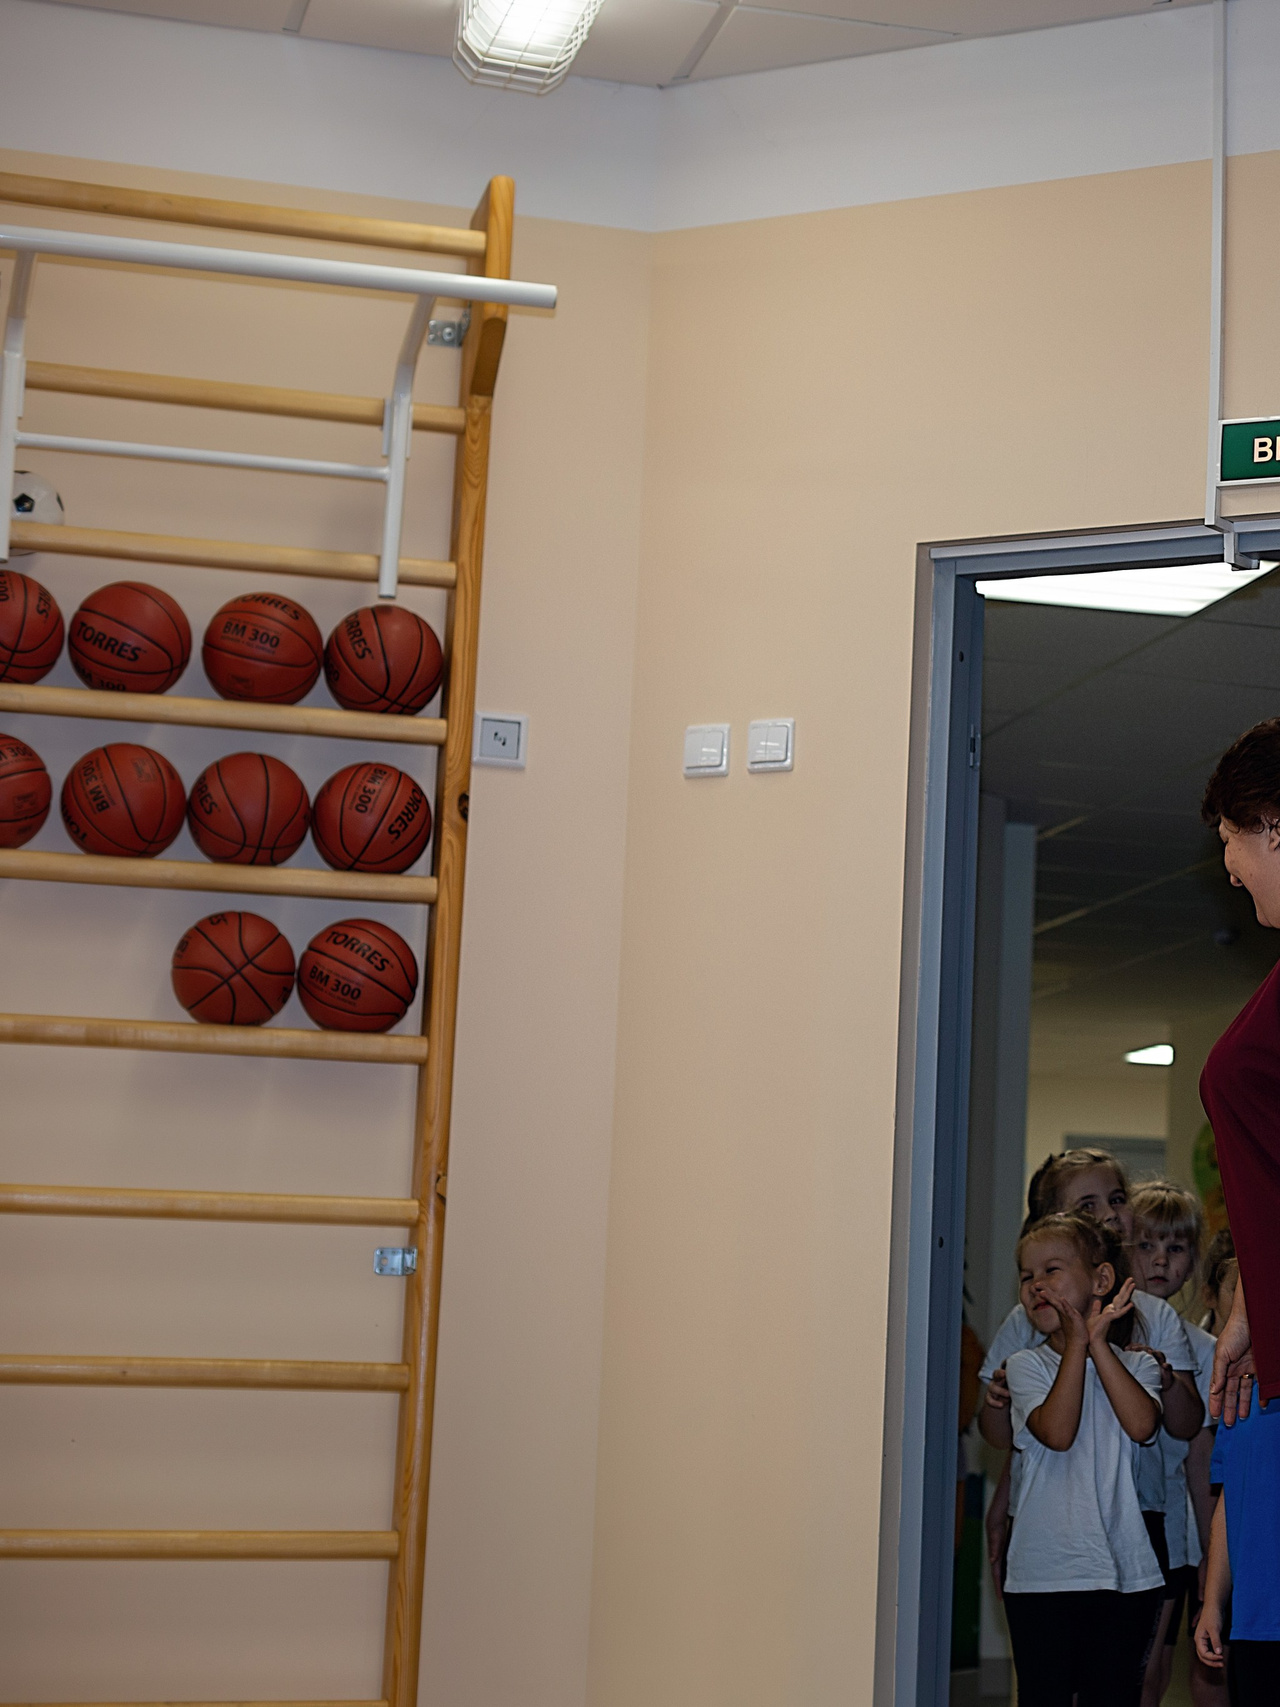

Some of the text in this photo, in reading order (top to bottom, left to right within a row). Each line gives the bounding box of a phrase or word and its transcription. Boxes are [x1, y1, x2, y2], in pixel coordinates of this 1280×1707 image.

[77, 621, 140, 662] TORRES
[223, 621, 247, 638] BM
[249, 629, 280, 649] 300
[367, 768, 387, 785] BM
[90, 785, 110, 813] BM
[355, 786, 375, 813] 300
[326, 931, 390, 972] TORRES
[309, 965, 330, 987] BM
[331, 980, 361, 1000] 300
